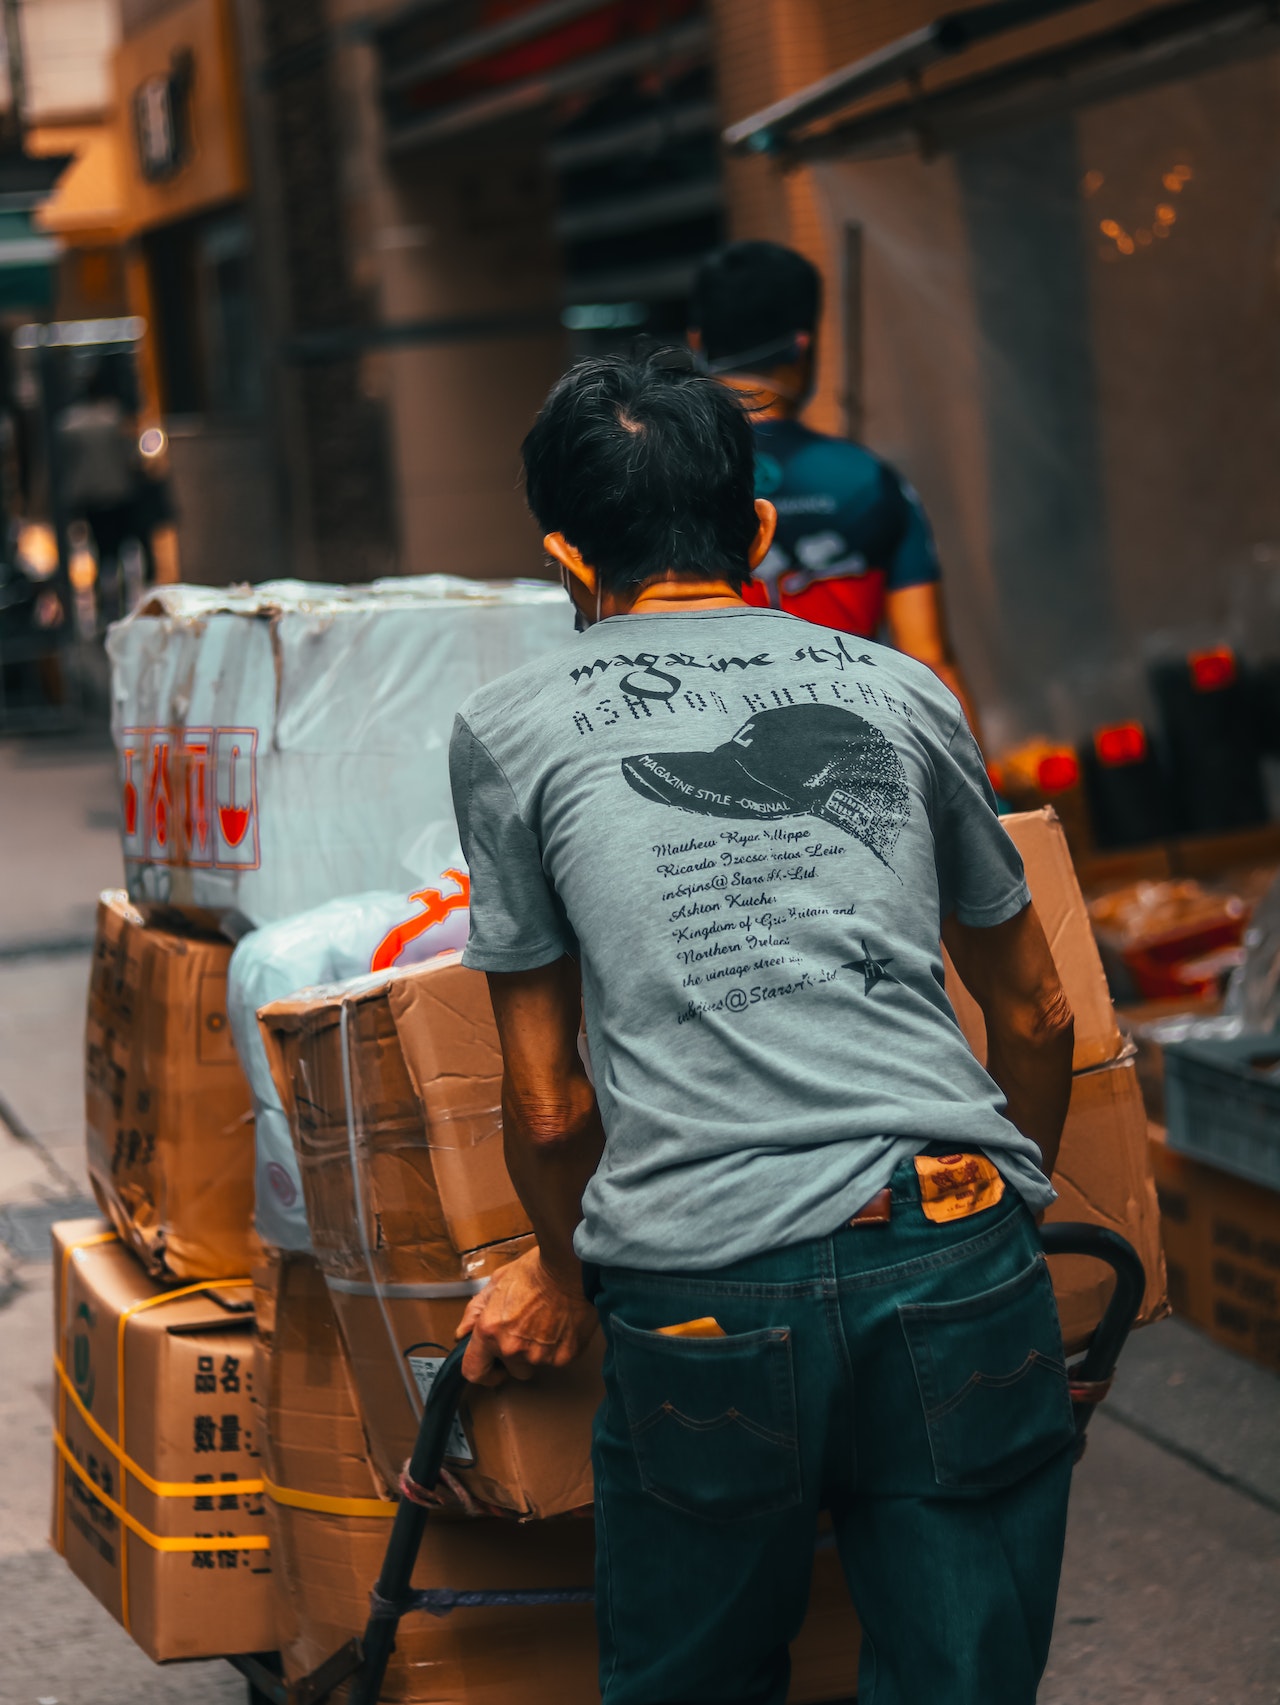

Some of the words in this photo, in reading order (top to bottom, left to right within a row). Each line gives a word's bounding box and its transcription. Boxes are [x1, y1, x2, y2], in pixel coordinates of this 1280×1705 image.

[569, 652, 775, 701] magazine
[790, 636, 878, 670] style
[638, 755, 695, 795] MAGAZINE
[695, 788, 732, 806] STYLE
[652, 838, 717, 858] Matthew
[657, 858, 717, 878] Ricardo
[669, 902, 722, 923] Ashton
[672, 920, 737, 944] Kingdom
[739, 916, 753, 932] of
[832, 904, 857, 916] and
[676, 943, 742, 965] Northern
[682, 972, 704, 988] the
[705, 963, 750, 979] vintage
[752, 956, 785, 972] street
